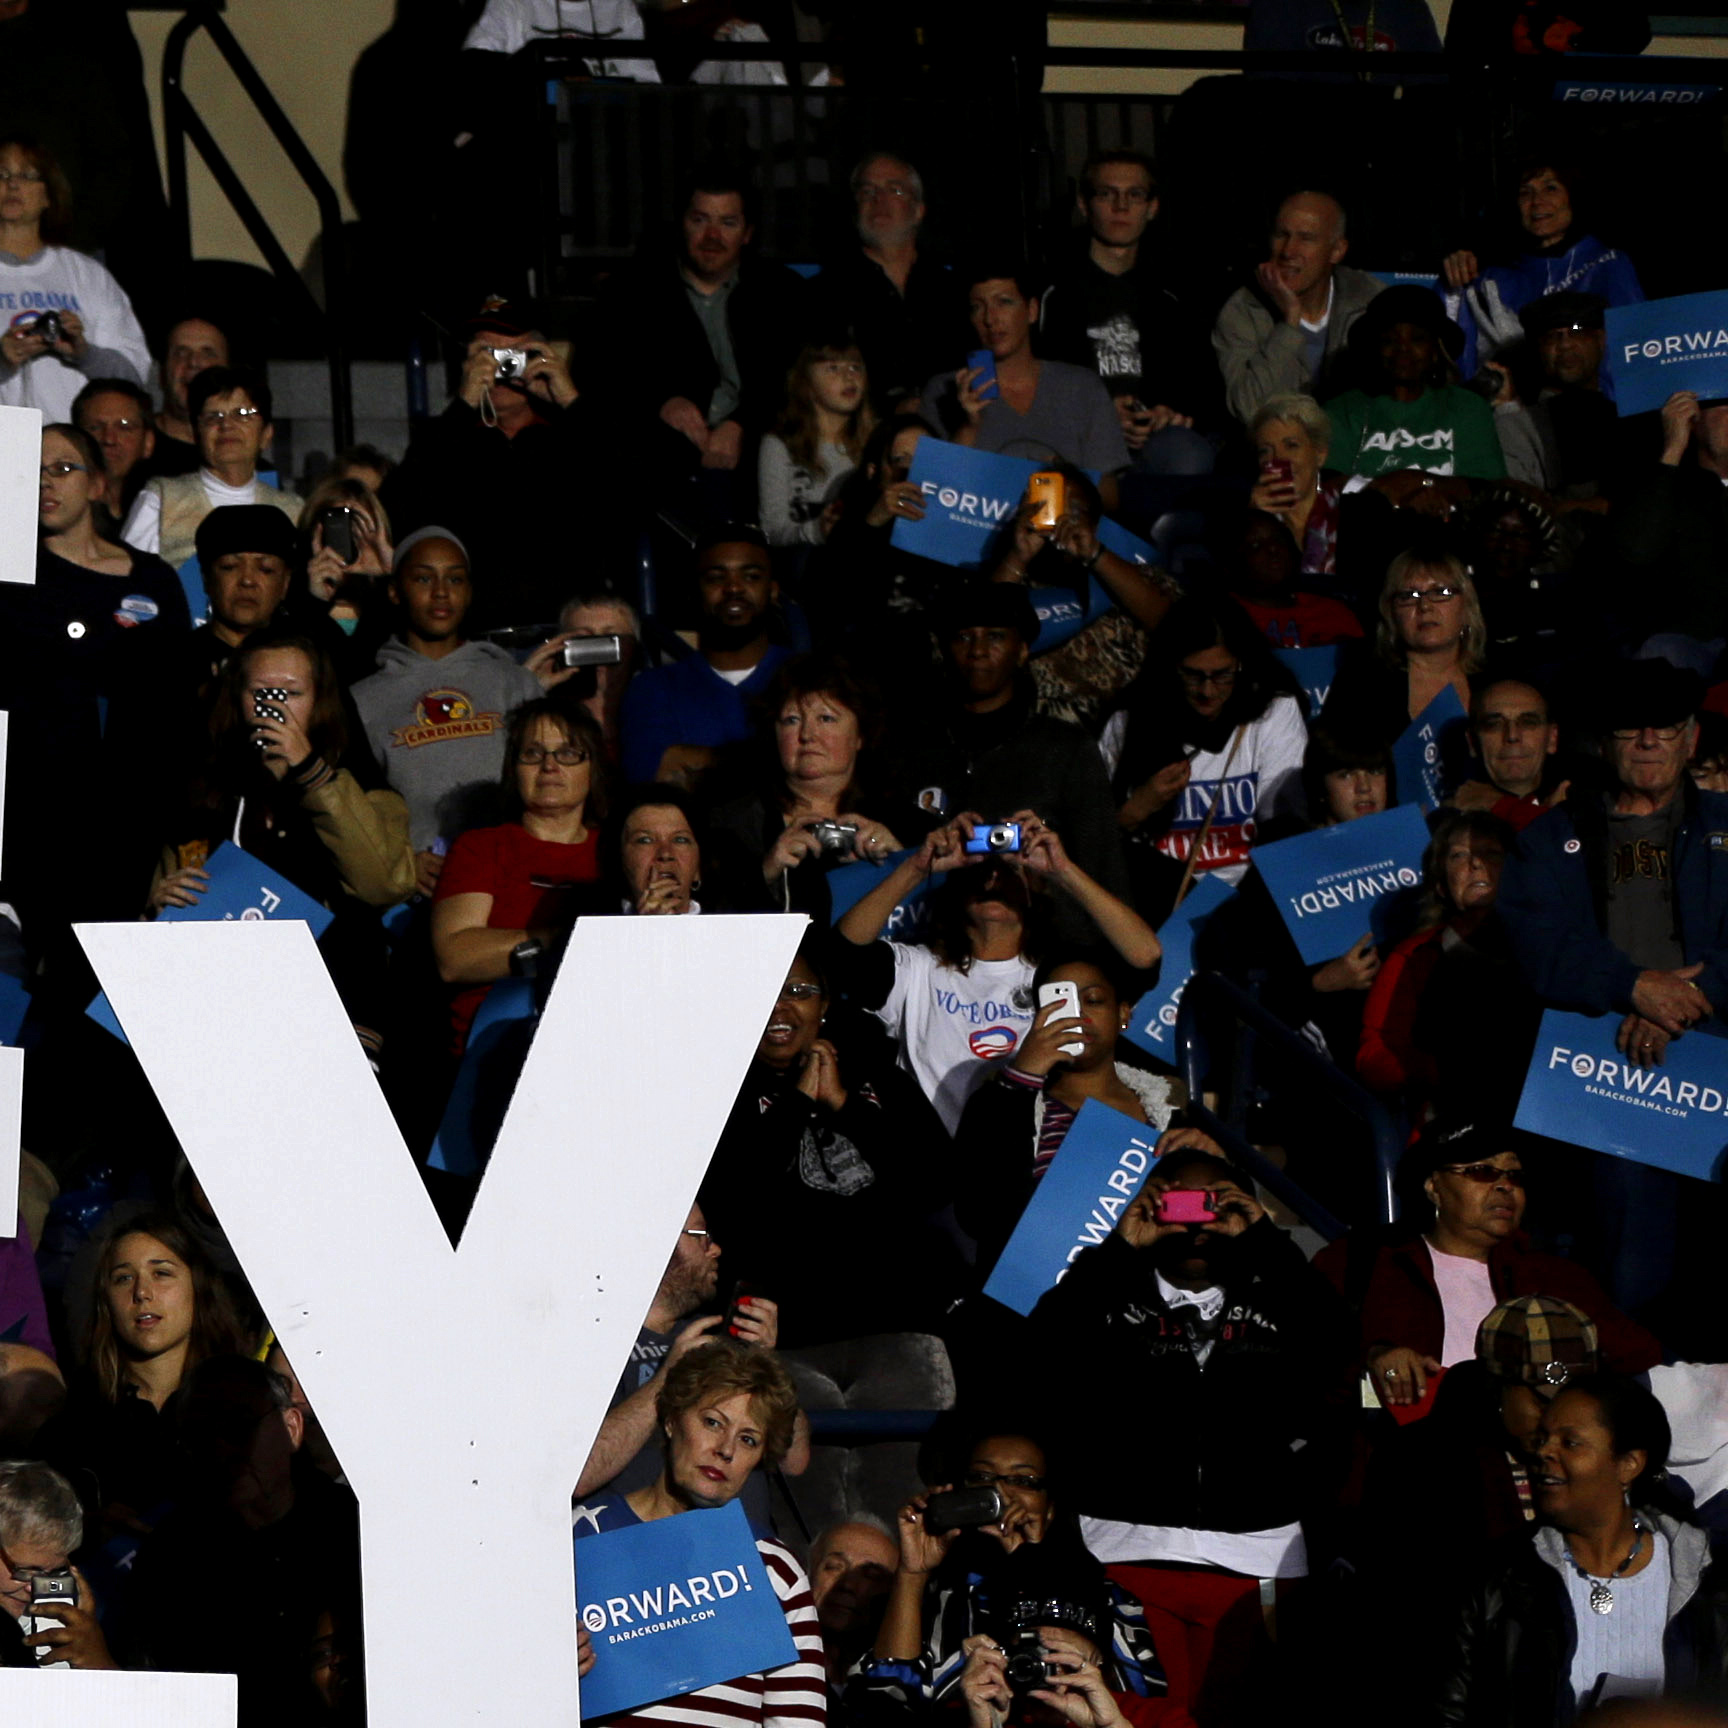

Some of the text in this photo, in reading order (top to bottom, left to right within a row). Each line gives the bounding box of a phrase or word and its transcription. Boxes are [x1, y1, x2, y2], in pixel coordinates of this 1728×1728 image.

[408, 722, 493, 743] CARDINALS
[1292, 867, 1424, 918] ORWARD!
[936, 990, 982, 1025] VOTE
[583, 1565, 754, 1634] ORWARD!
[608, 1609, 716, 1645] BARACKOBAMA.COM
